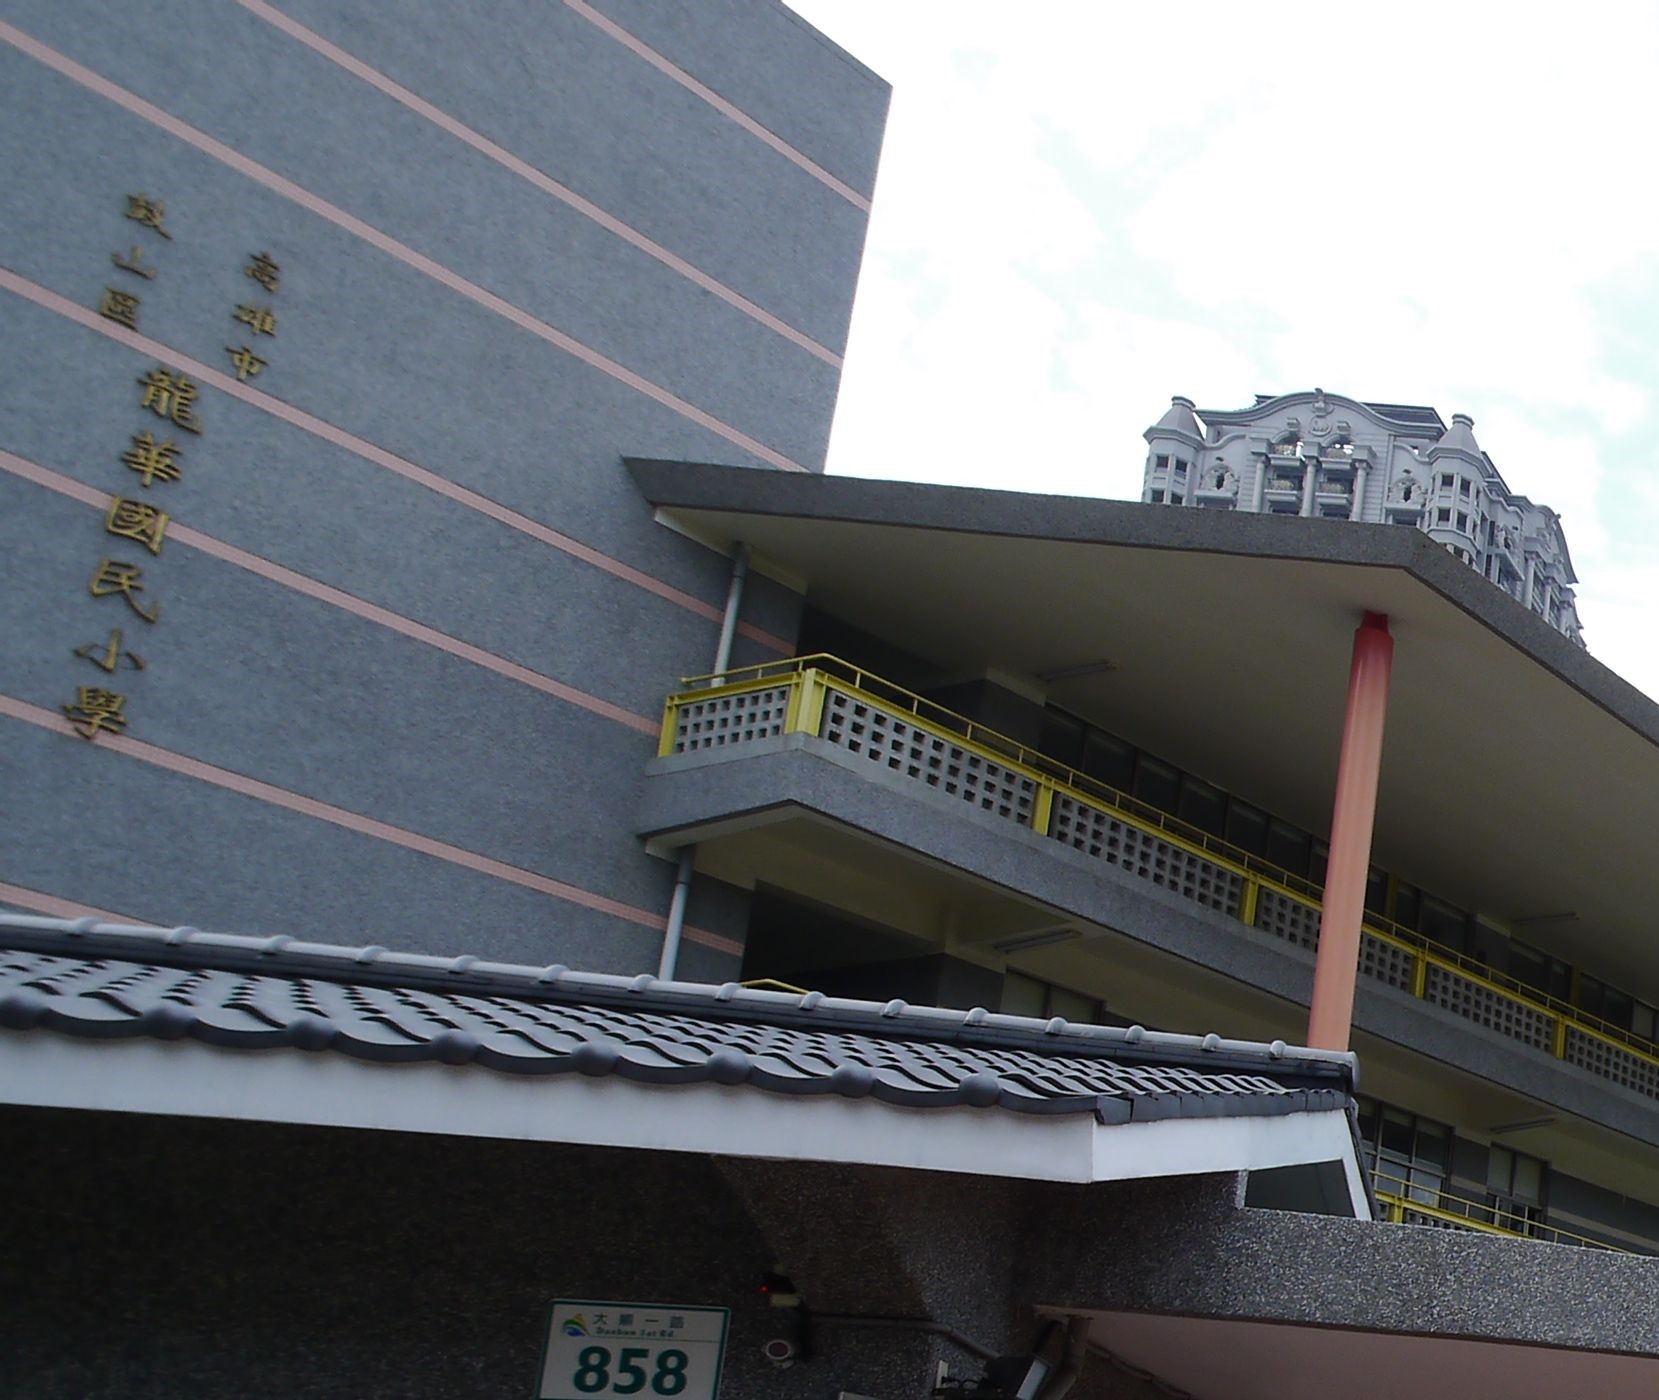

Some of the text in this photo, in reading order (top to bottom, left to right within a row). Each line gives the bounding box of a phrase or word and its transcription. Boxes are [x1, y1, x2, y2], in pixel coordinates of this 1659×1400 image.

[223, 250, 281, 380] 高雄市
[62, 367, 202, 739] 龍華國民小學
[573, 1345, 689, 1396] 858
